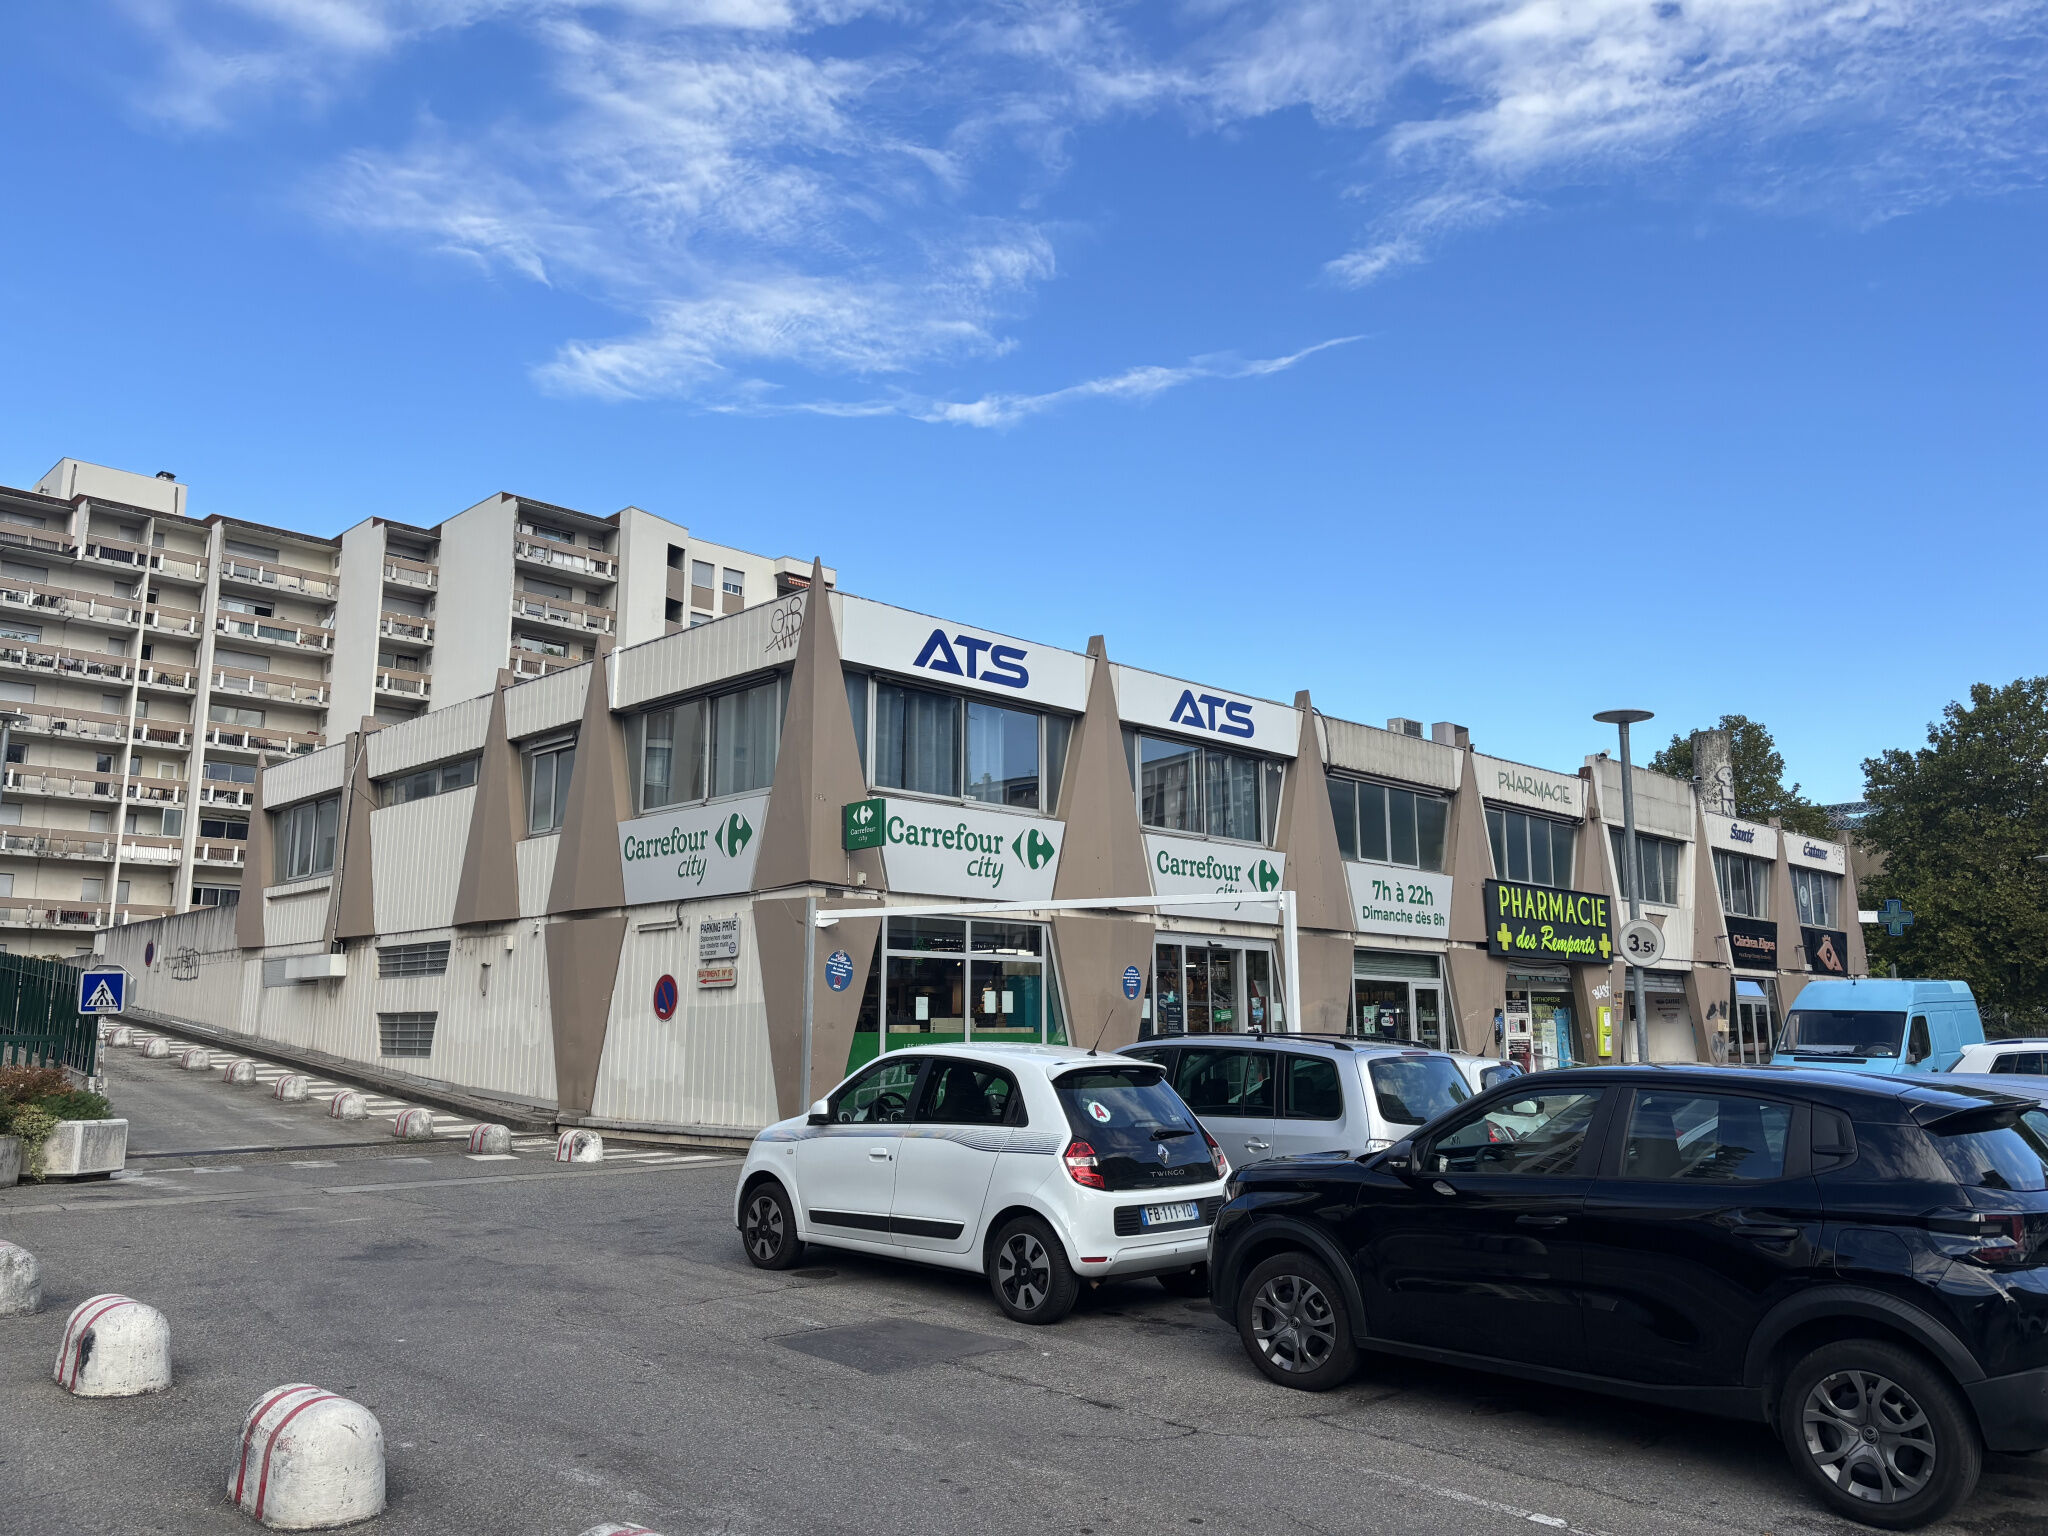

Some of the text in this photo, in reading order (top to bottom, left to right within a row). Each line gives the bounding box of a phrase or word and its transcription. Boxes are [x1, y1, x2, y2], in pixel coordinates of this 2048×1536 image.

[913, 628, 1029, 689] ATS
[1169, 689, 1255, 738] ATS
[1498, 770, 1573, 805] PHARMACIE
[624, 826, 709, 862] Carrefour
[850, 826, 877, 836] Carrefour
[887, 815, 1004, 855] Carrefour
[677, 854, 708, 886] city
[966, 855, 1004, 889] city
[1156, 850, 1241, 882] Carrefour
[1372, 880, 1434, 906] 7h à 22h
[1498, 885, 1607, 928] PHARMACIE
[700, 922, 721, 934] PARKING
[1362, 905, 1445, 927] Dimanche dès 8h
[1515, 924, 1597, 959] des Remparts
[1628, 933, 1656, 953] 3.5t
[1733, 934, 1758, 948] Chicken
[1093, 1104, 1107, 1119] A
[1150, 1168, 1185, 1178] TWINGO
